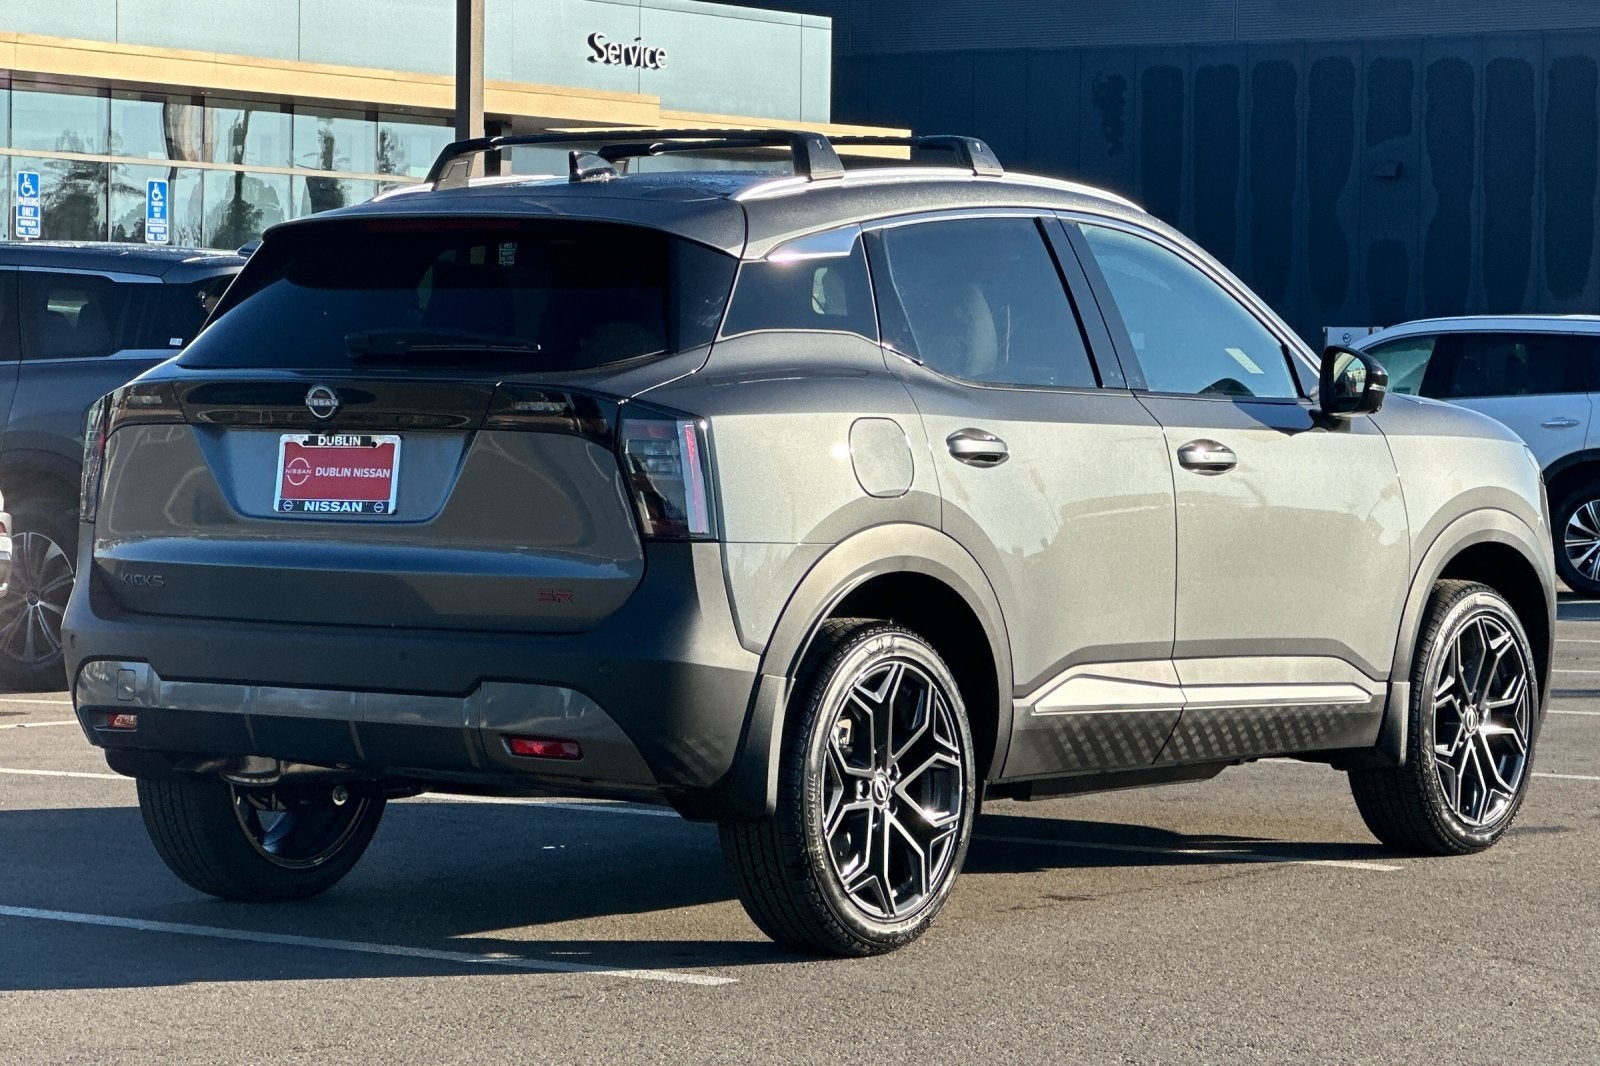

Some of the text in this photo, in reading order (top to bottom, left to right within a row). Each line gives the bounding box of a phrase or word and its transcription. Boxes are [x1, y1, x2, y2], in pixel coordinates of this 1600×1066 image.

[589, 32, 667, 69] Service
[22, 206, 35, 216] ONLY
[305, 398, 339, 407] NISSAN
[318, 436, 360, 447] DUBLIN
[315, 466, 391, 478] DUBLIN NISSAN
[303, 501, 363, 512] NISSAN
[120, 572, 164, 587] KICKS
[537, 590, 572, 603] SR
